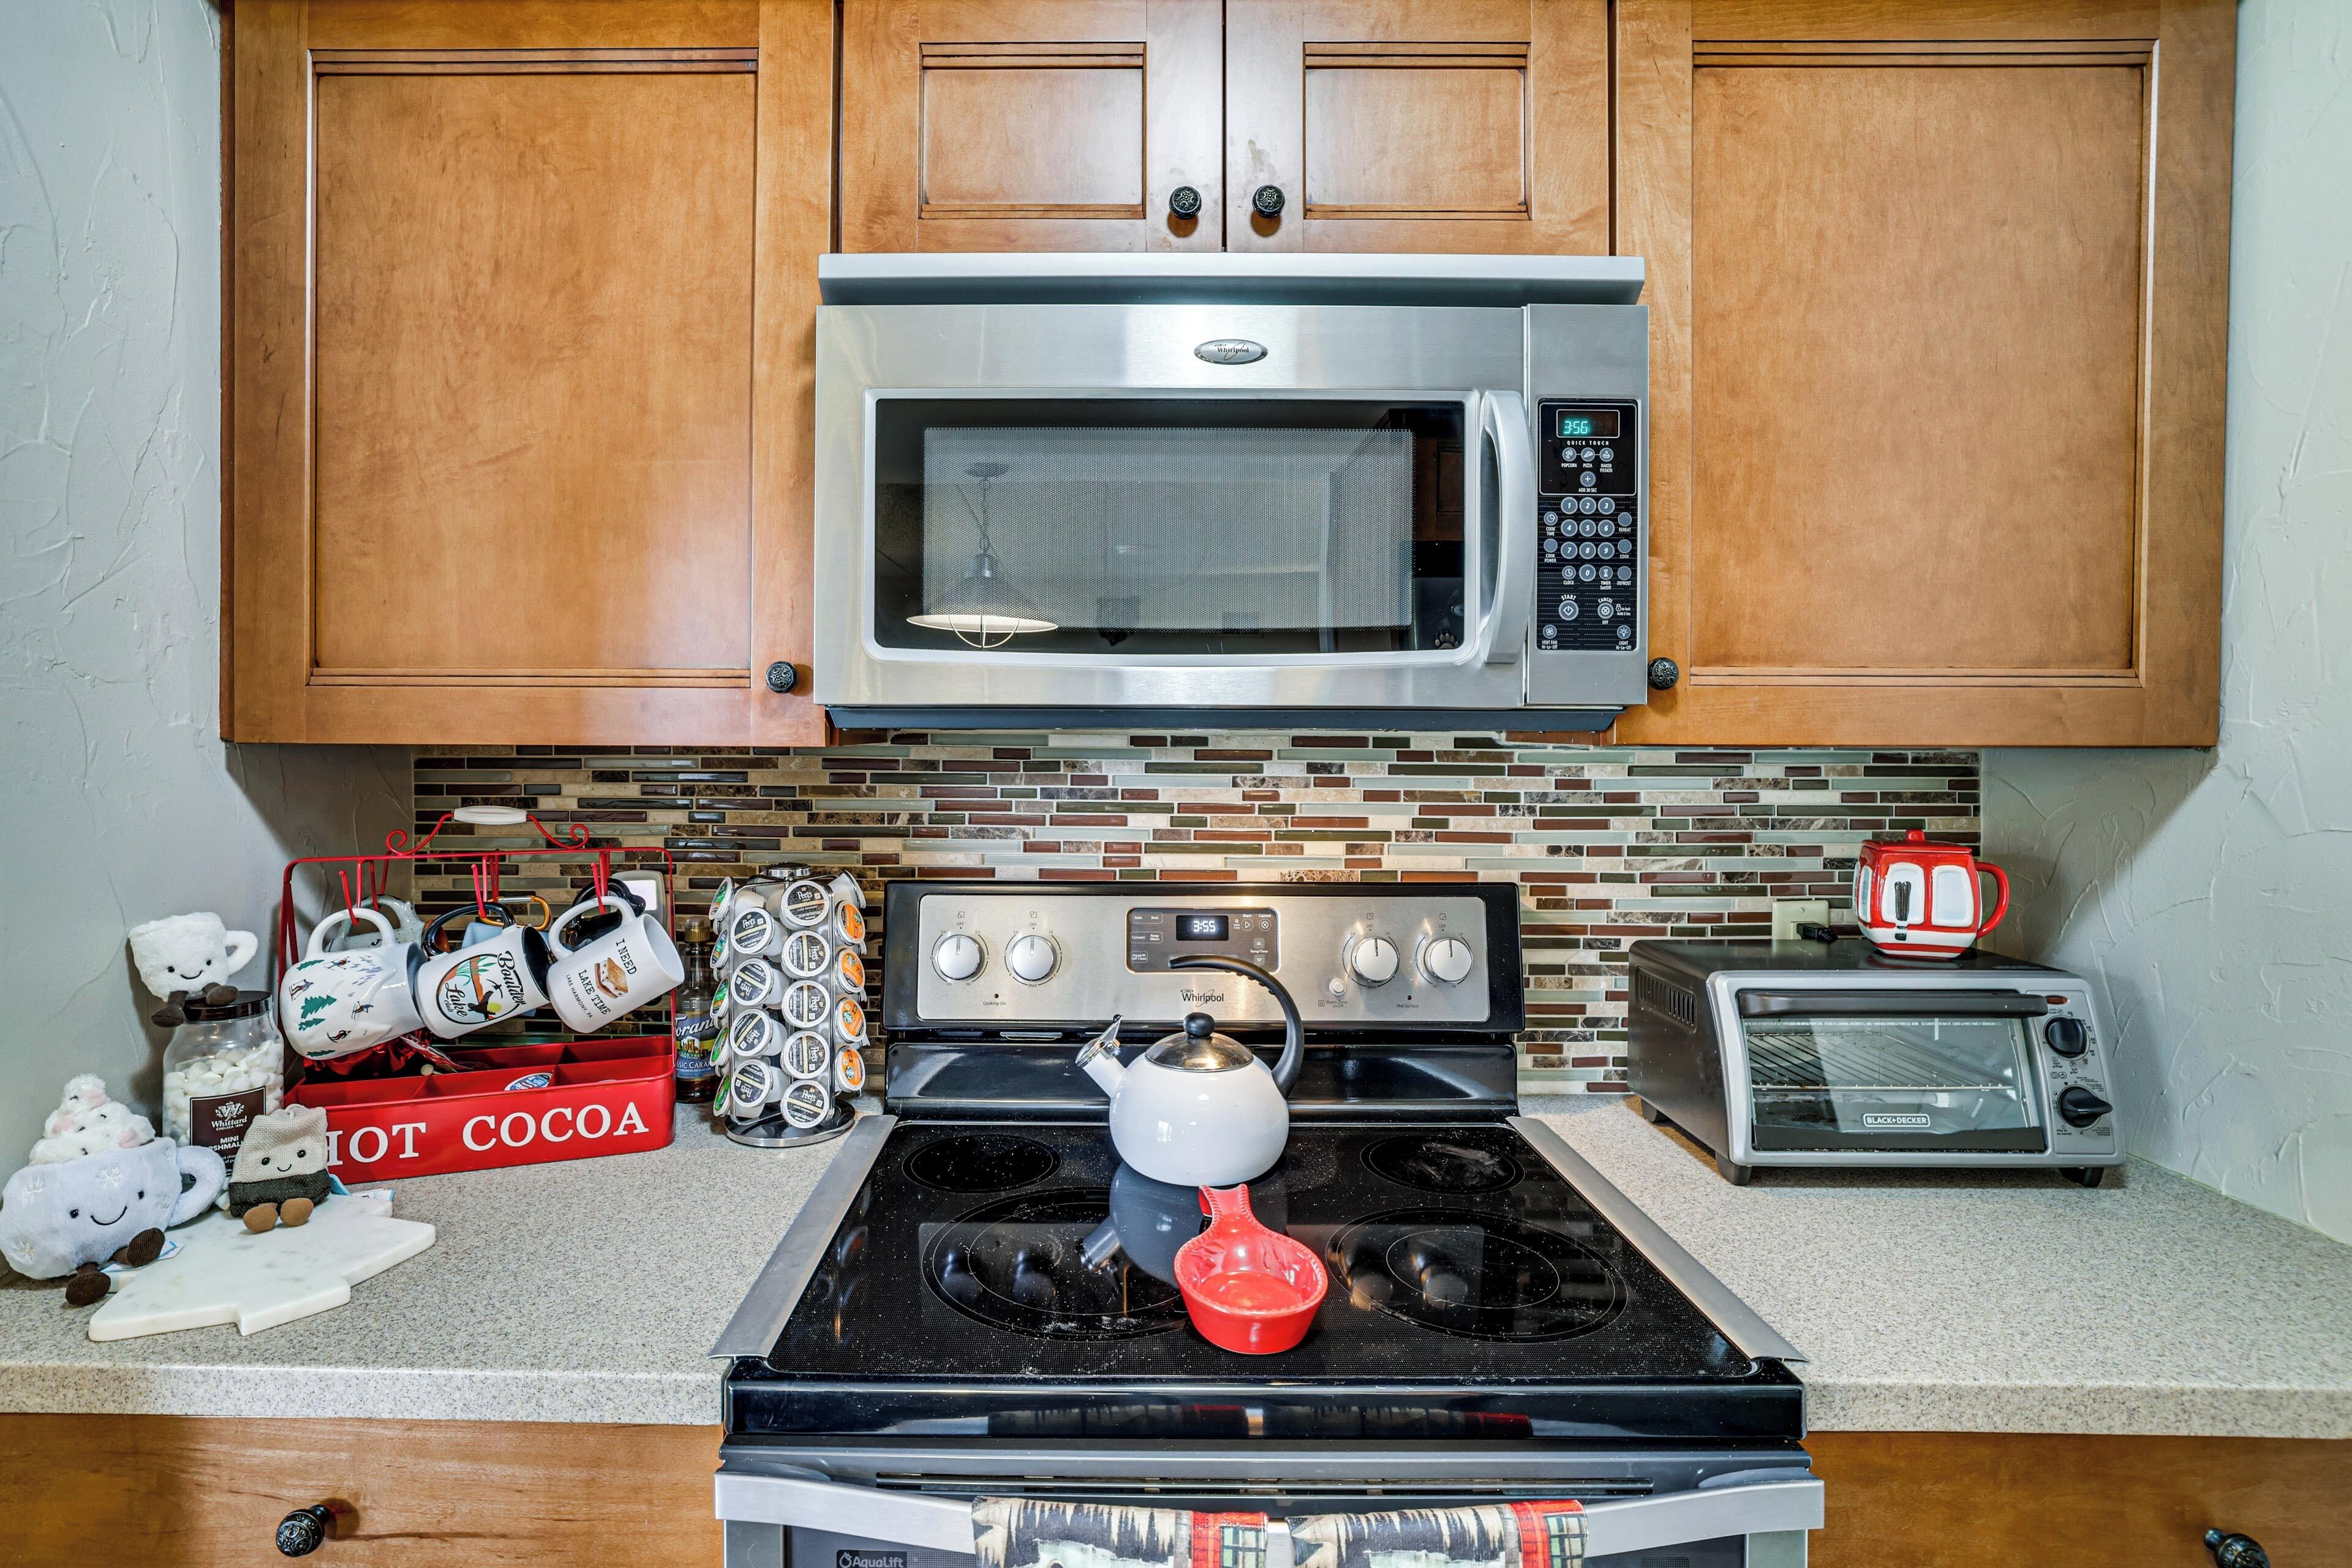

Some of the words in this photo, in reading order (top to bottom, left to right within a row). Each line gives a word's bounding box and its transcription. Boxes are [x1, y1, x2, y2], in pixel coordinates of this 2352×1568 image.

[1193, 921, 1216, 932] 3:55
[616, 938, 625, 947] I
[618, 946, 637, 975] NEED
[497, 950, 527, 1006] Boulder
[445, 982, 468, 1017] Lake
[565, 974, 574, 987] LAKE
[570, 987, 587, 1013] HARMONY,
[578, 970, 595, 995] LAKE
[591, 994, 611, 1015] TIME
[1182, 991, 1224, 1005] Whirlpool
[444, 1000, 454, 1013] club
[211, 1115, 247, 1128] Whittard
[462, 1101, 649, 1152] COCOA
[220, 1135, 239, 1144] MINI
[852, 1556, 903, 1568] AquaLift
